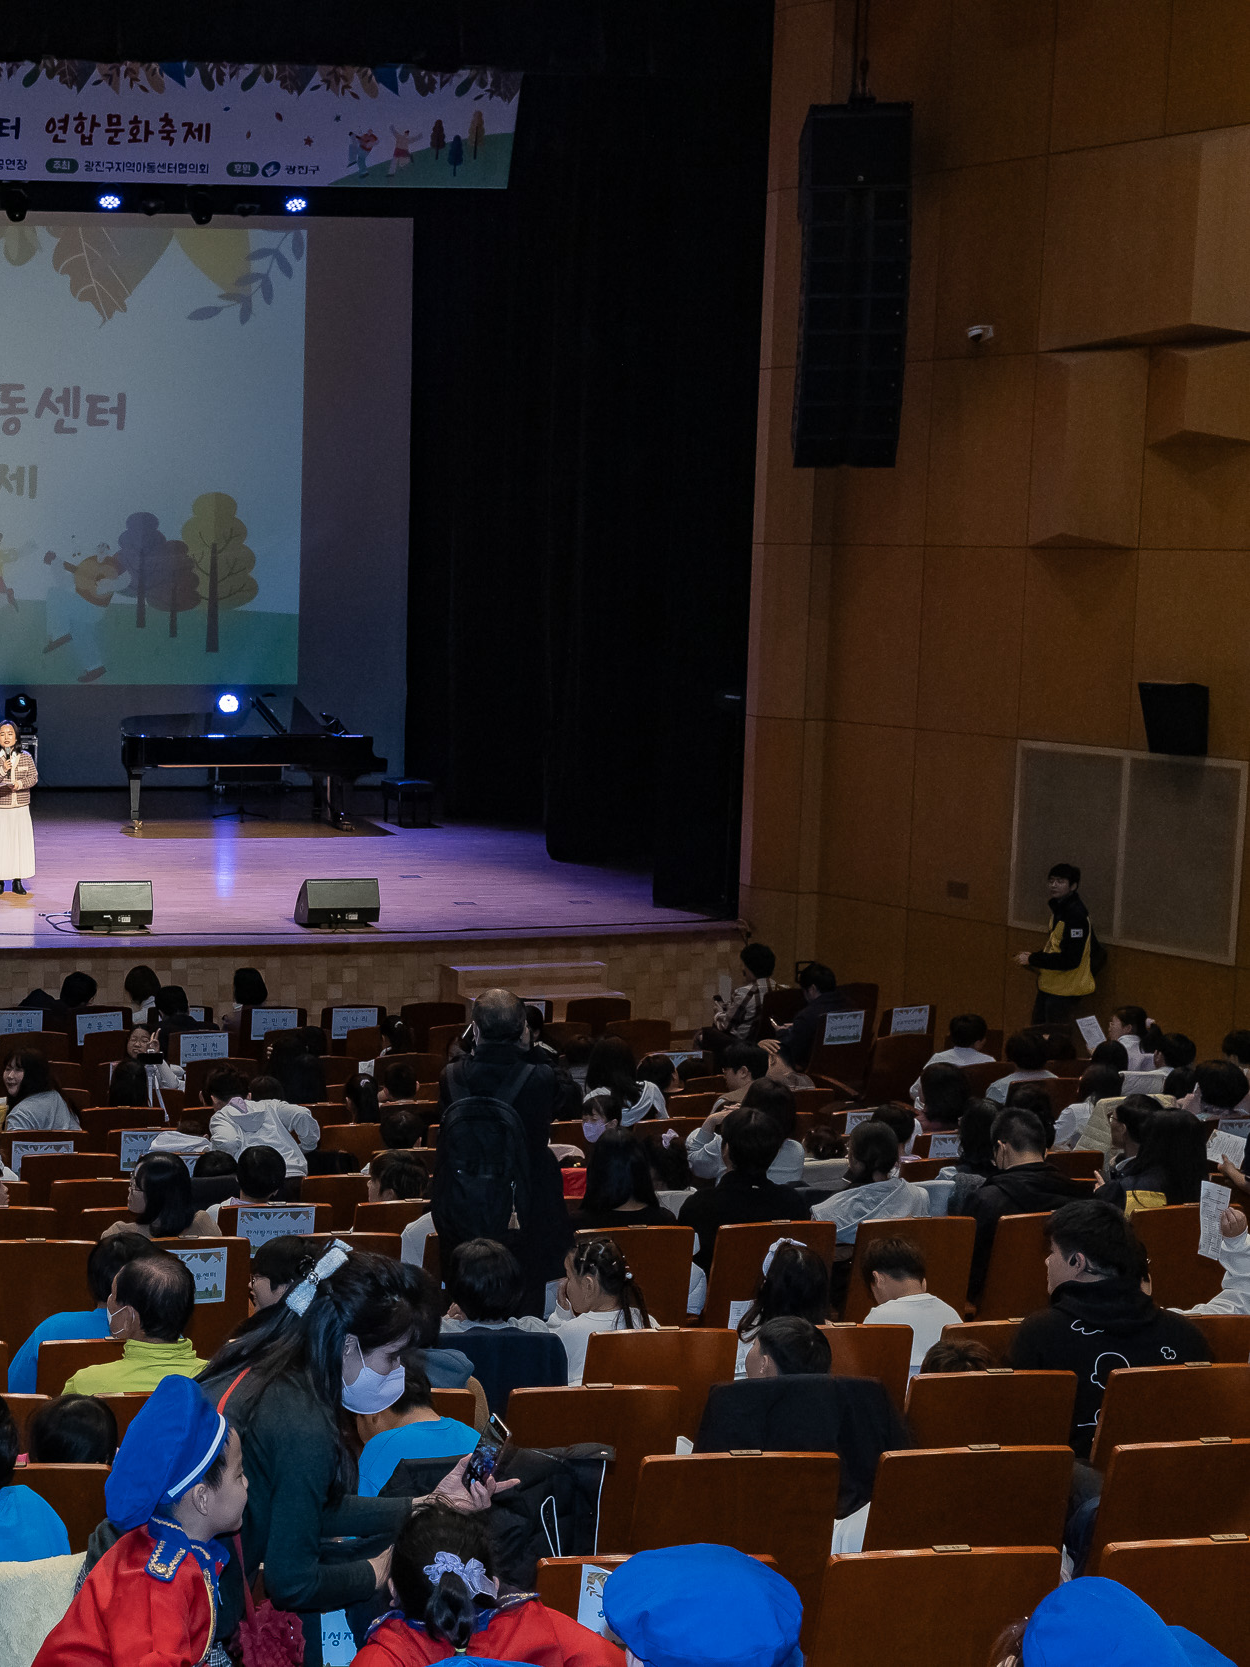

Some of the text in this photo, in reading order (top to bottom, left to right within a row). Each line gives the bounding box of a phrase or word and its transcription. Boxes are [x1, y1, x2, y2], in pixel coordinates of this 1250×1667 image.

[44, 110, 212, 147] 연합문화축제
[52, 160, 71, 171] 주최
[83, 160, 210, 175] 광진구지역아동센터협의회
[285, 164, 321, 175] 광진구
